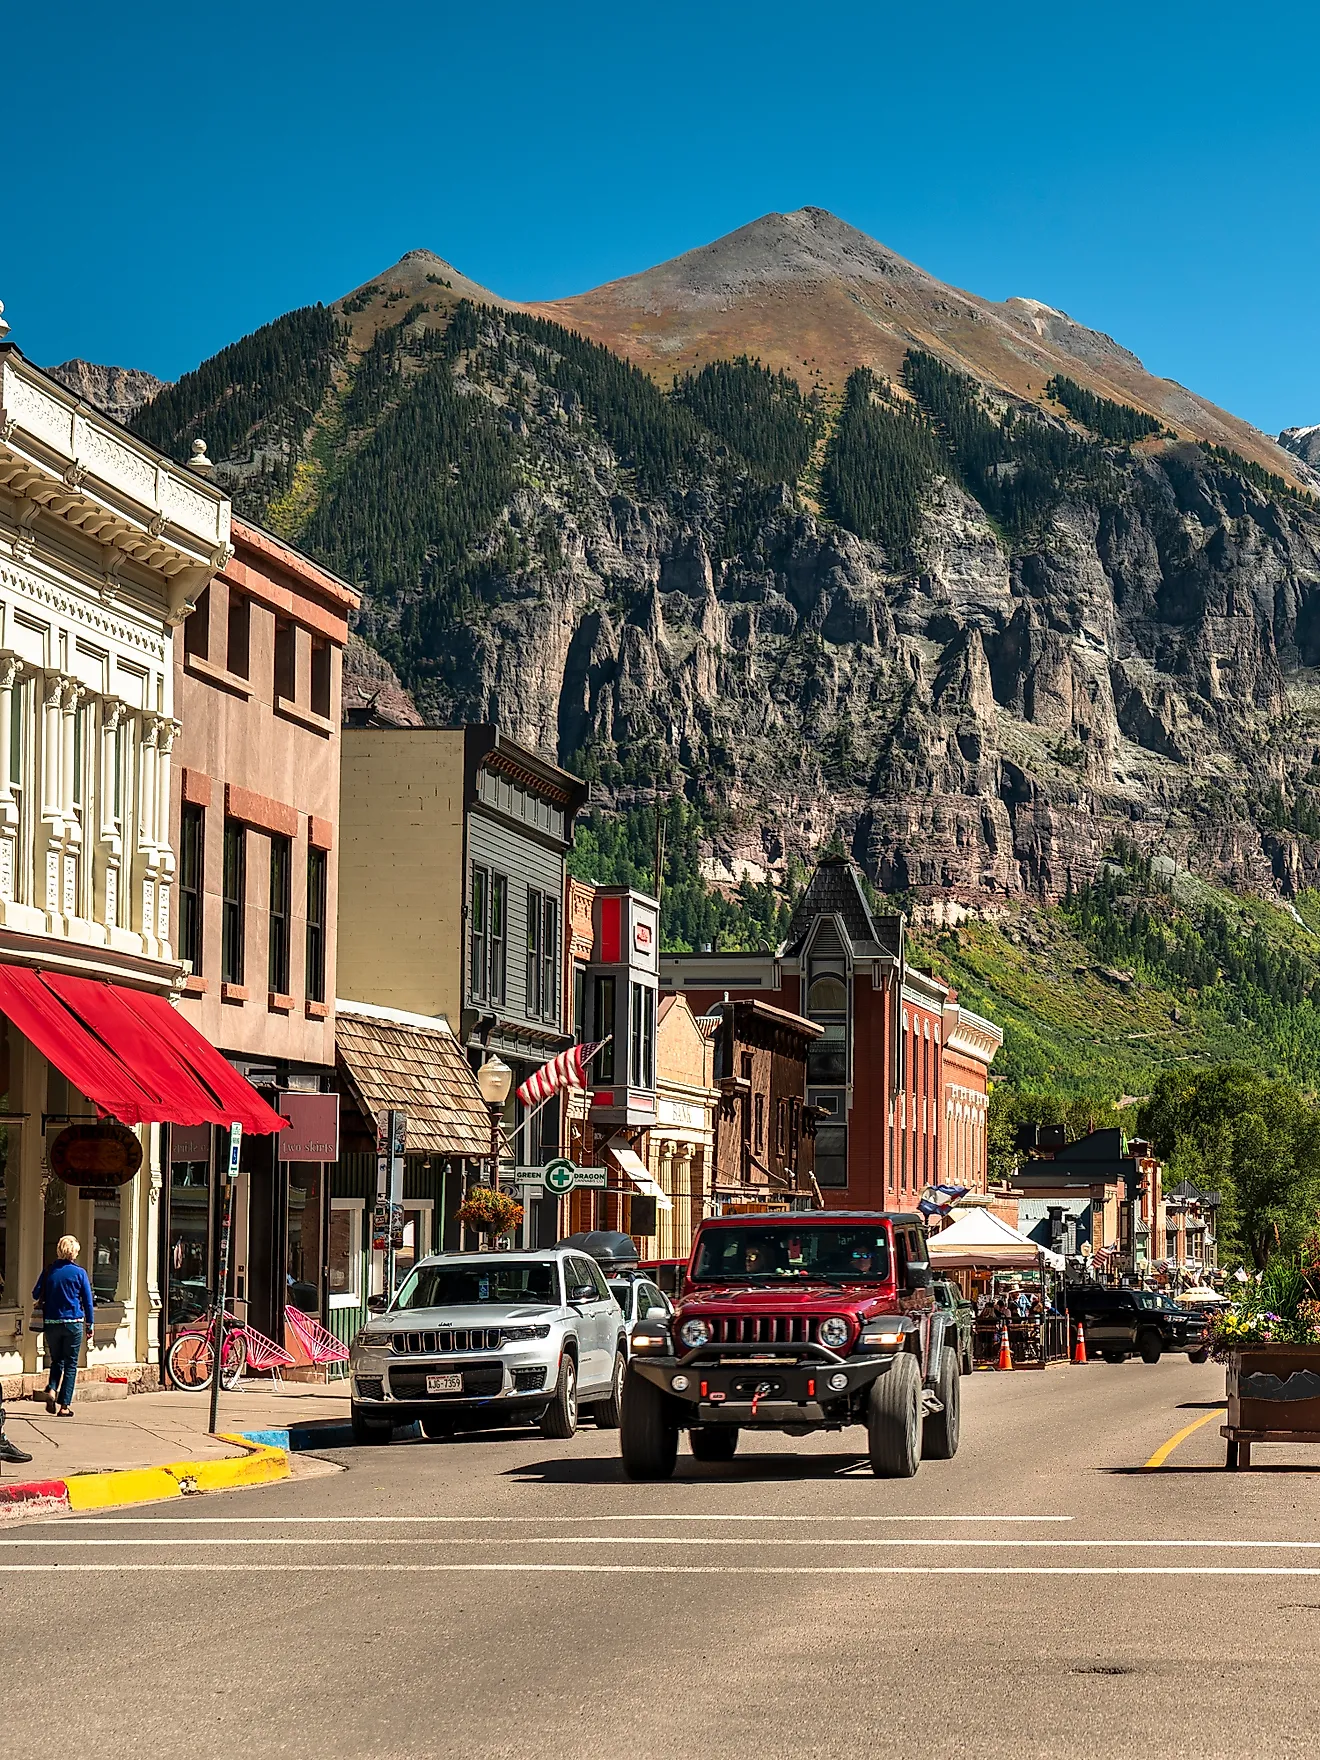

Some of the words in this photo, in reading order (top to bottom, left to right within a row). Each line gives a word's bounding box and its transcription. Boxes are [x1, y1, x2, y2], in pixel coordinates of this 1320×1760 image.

[282, 1142, 301, 1153] two
[304, 1140, 334, 1154] skirts
[516, 1171, 542, 1179] GREEN
